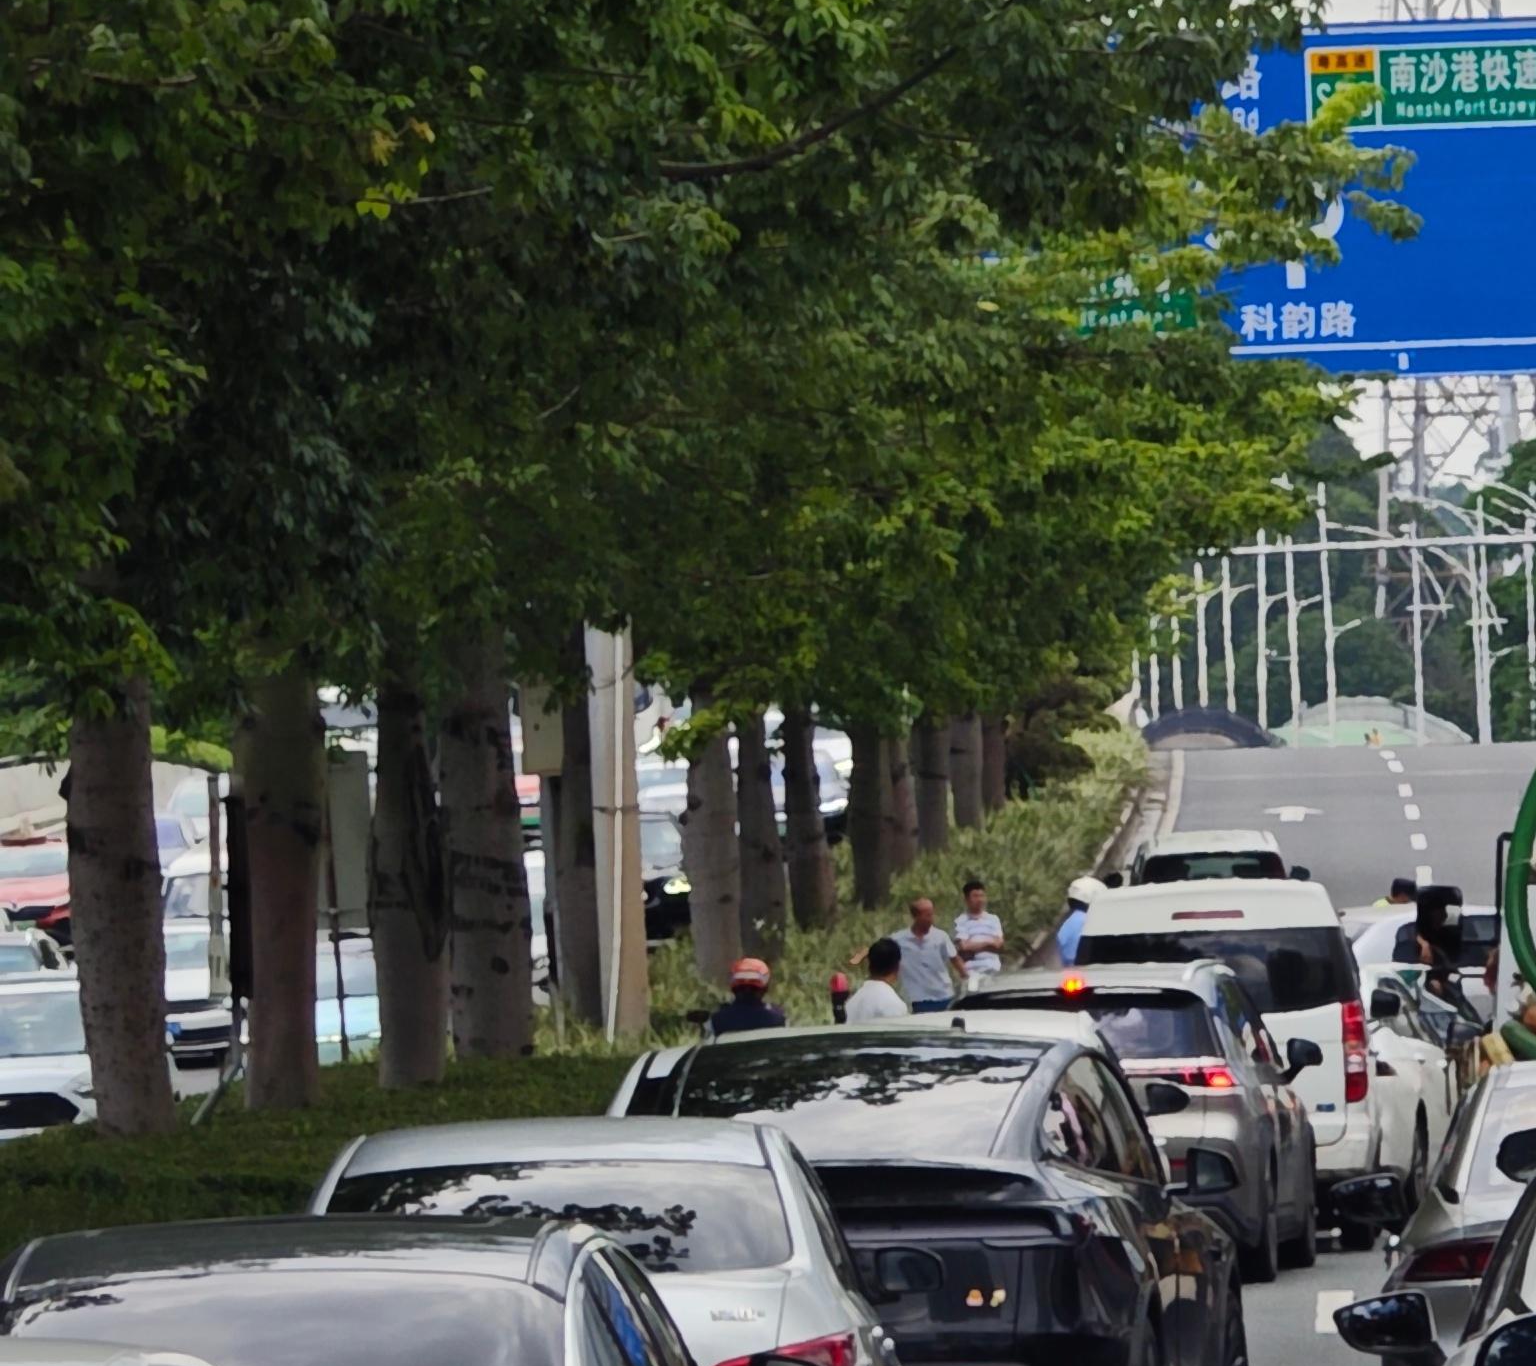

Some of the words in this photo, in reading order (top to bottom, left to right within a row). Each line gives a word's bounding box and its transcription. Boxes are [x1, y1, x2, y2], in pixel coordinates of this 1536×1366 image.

[1395, 101, 1452, 118] Nansha
[1454, 99, 1486, 116] Port
[1240, 300, 1357, 341] 科韵路
